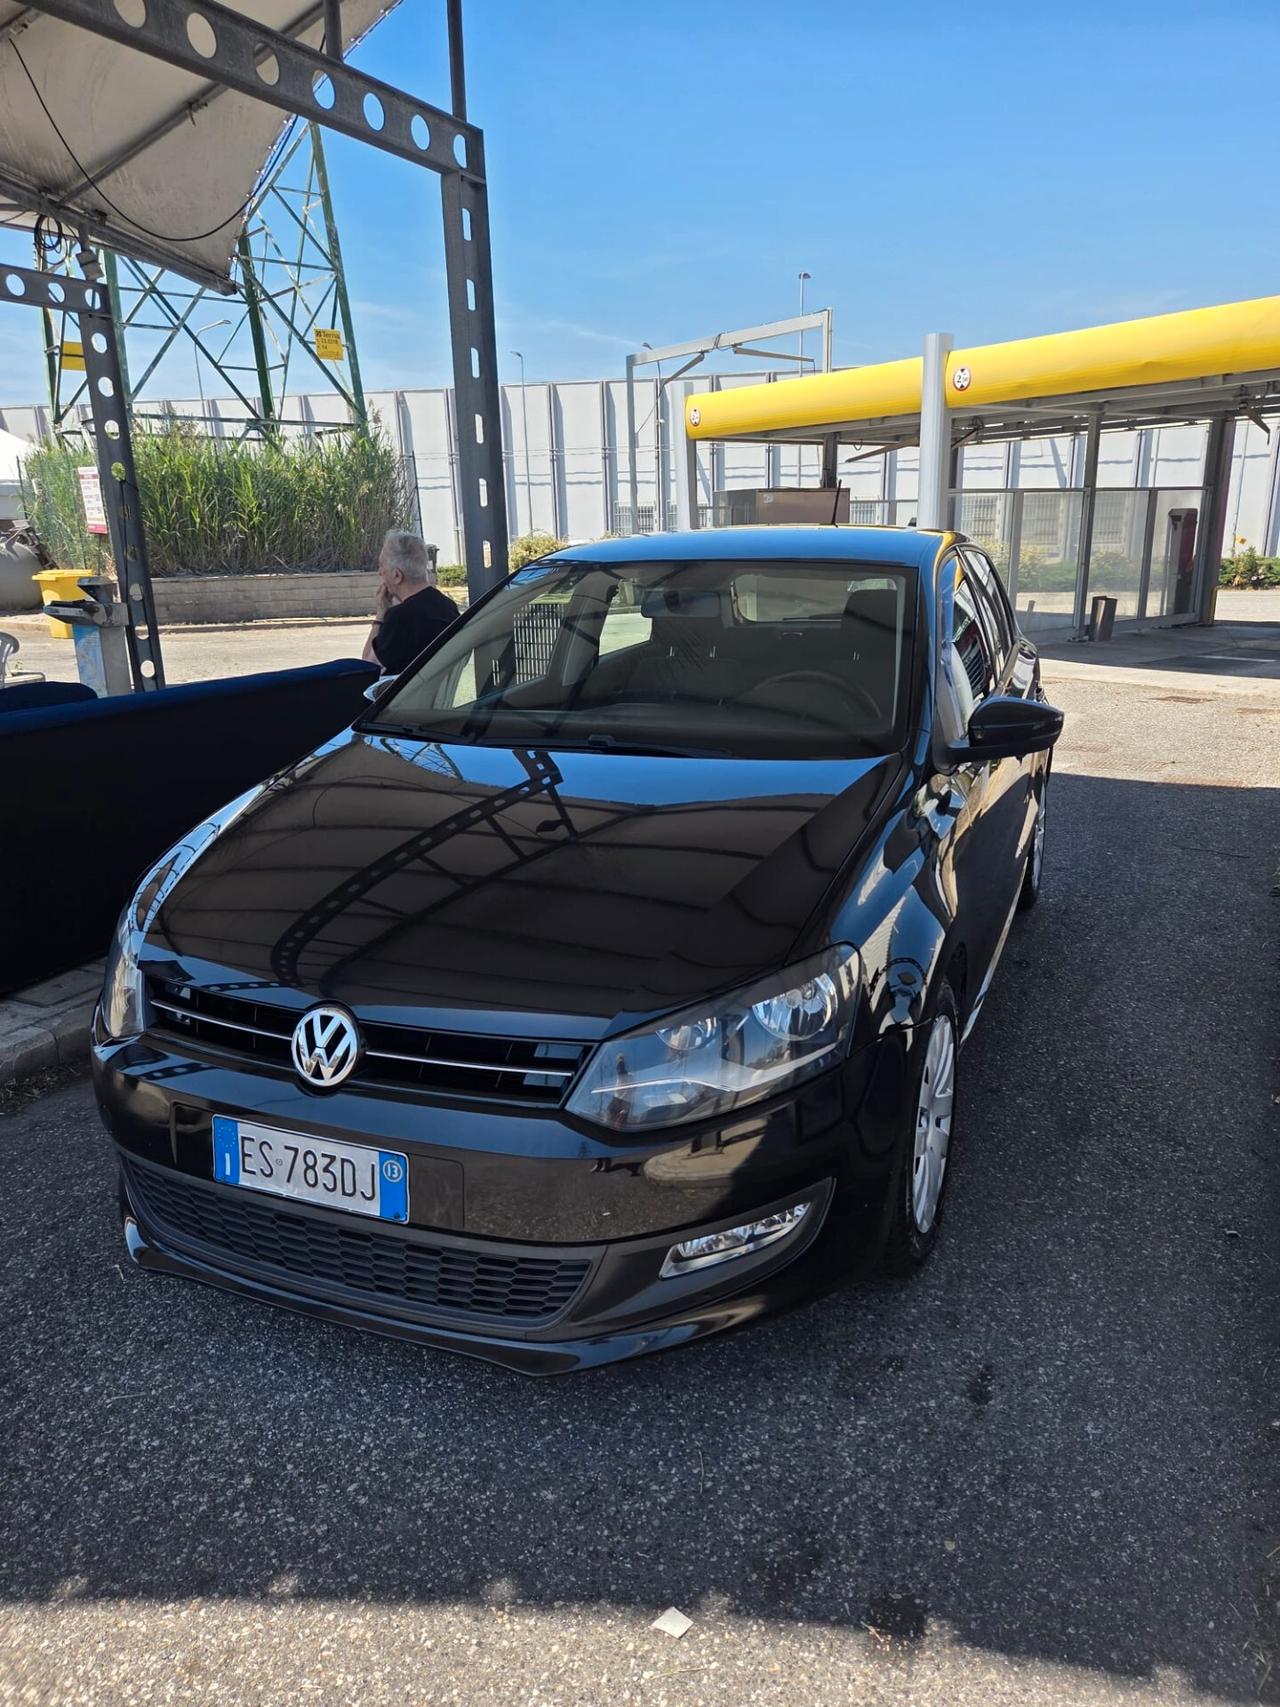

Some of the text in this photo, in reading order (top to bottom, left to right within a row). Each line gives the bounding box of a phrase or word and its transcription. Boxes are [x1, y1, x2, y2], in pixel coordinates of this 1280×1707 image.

[240, 1135, 274, 1178] ES
[284, 1145, 376, 1201] 783DJ
[387, 1163, 398, 1178] 13
